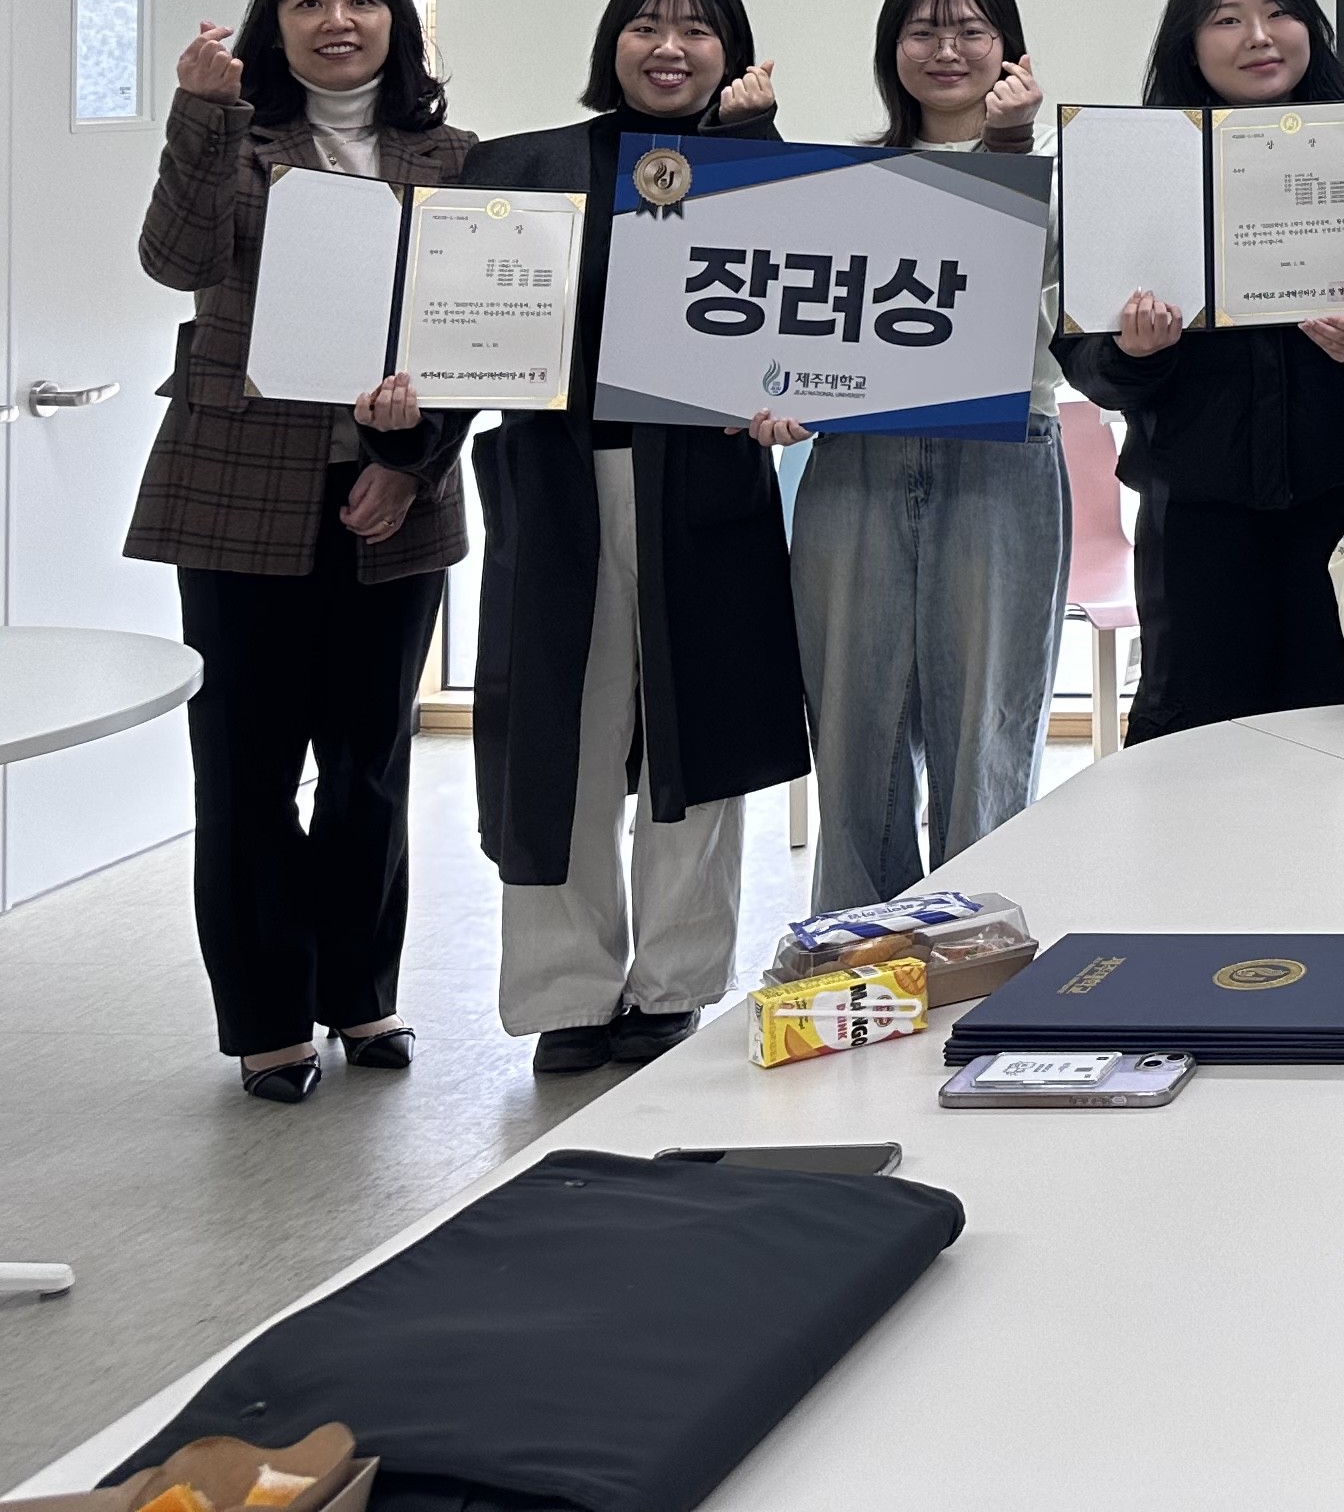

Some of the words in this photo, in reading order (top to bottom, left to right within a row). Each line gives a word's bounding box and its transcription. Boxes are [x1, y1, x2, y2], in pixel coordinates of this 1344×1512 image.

[685, 246, 968, 347] 장려상
[795, 372, 867, 391] 제주대학교
[835, 1002, 848, 1041] DINK
[849, 983, 869, 1048] MANGO
